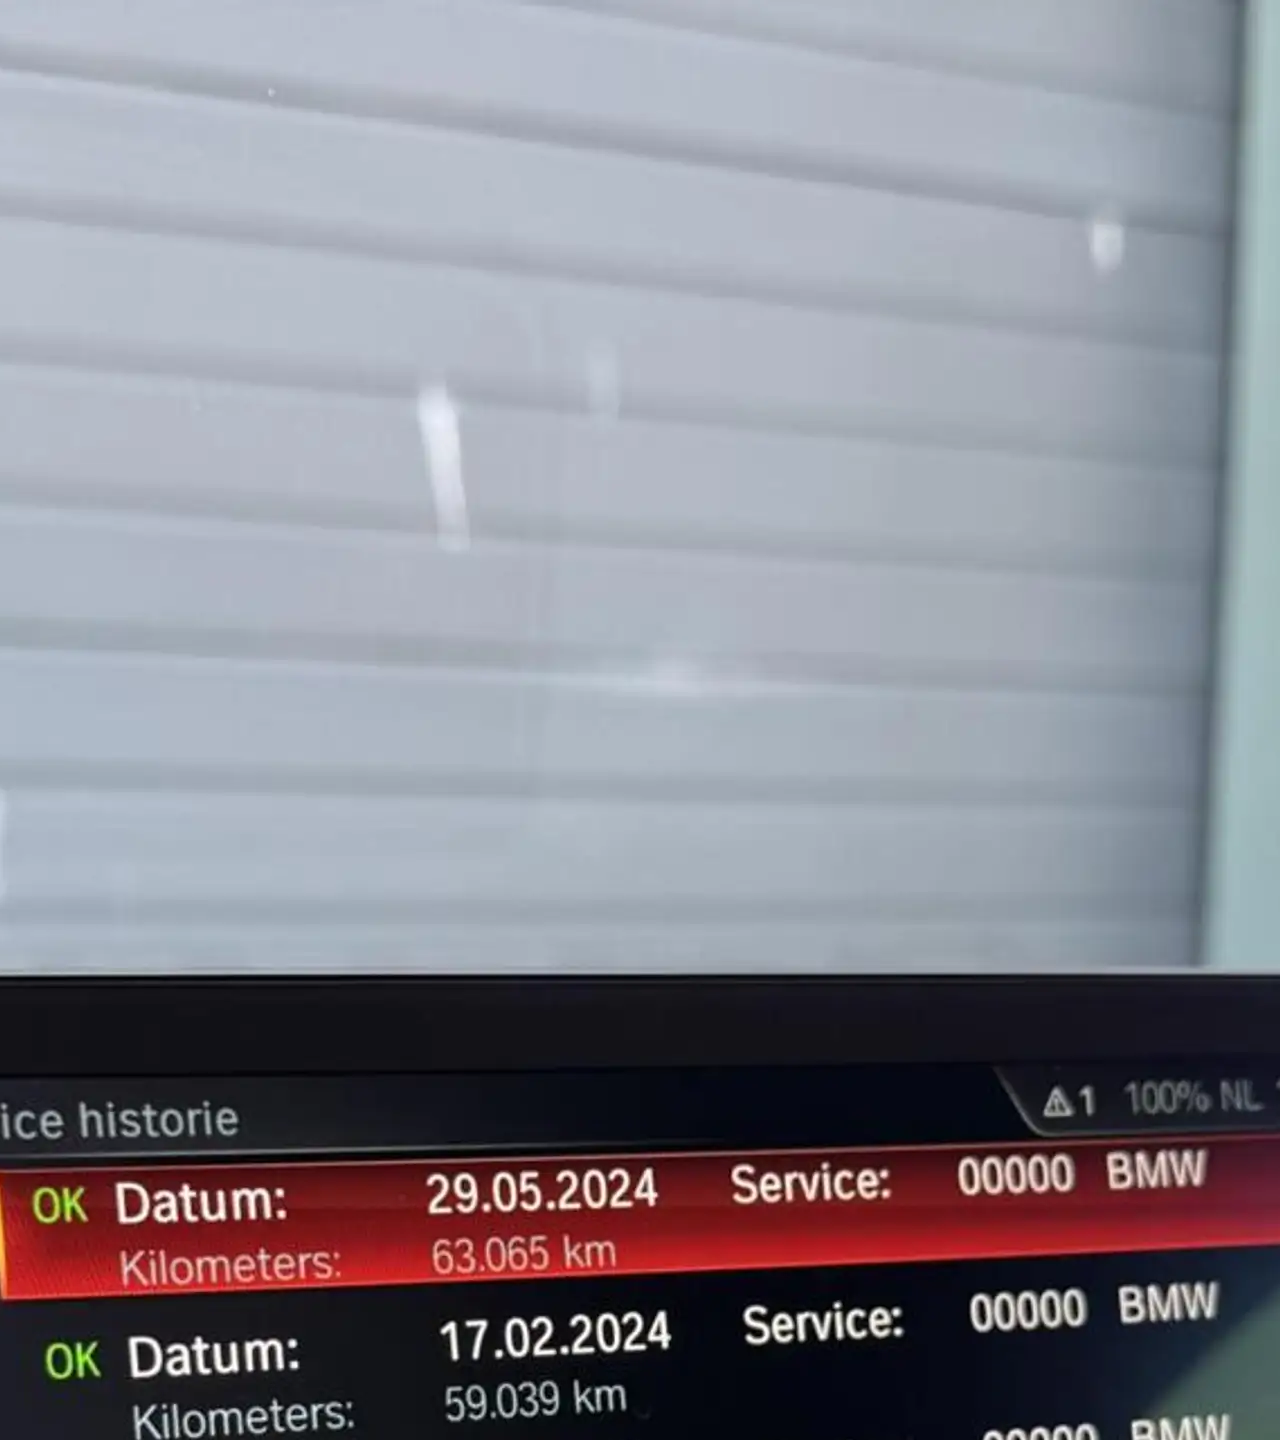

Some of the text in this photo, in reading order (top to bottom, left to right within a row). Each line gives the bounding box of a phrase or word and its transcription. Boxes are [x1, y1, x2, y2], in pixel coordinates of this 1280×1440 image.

[79, 1101, 239, 1138] historie
[1081, 1086, 1095, 1115] 1
[1126, 1081, 1209, 1115] 100%
[1220, 1081, 1263, 1111] NL
[32, 1150, 1206, 1224] OK Datum: 29.05.2024 Service: 00000 BMW
[120, 1232, 618, 1286] Kilometers: 63.065 km
[46, 1282, 1218, 1380] OK Datum: 17.02.2024 Service: 00000 BMW
[133, 1378, 628, 1440] Kilometers: 59.039 km
